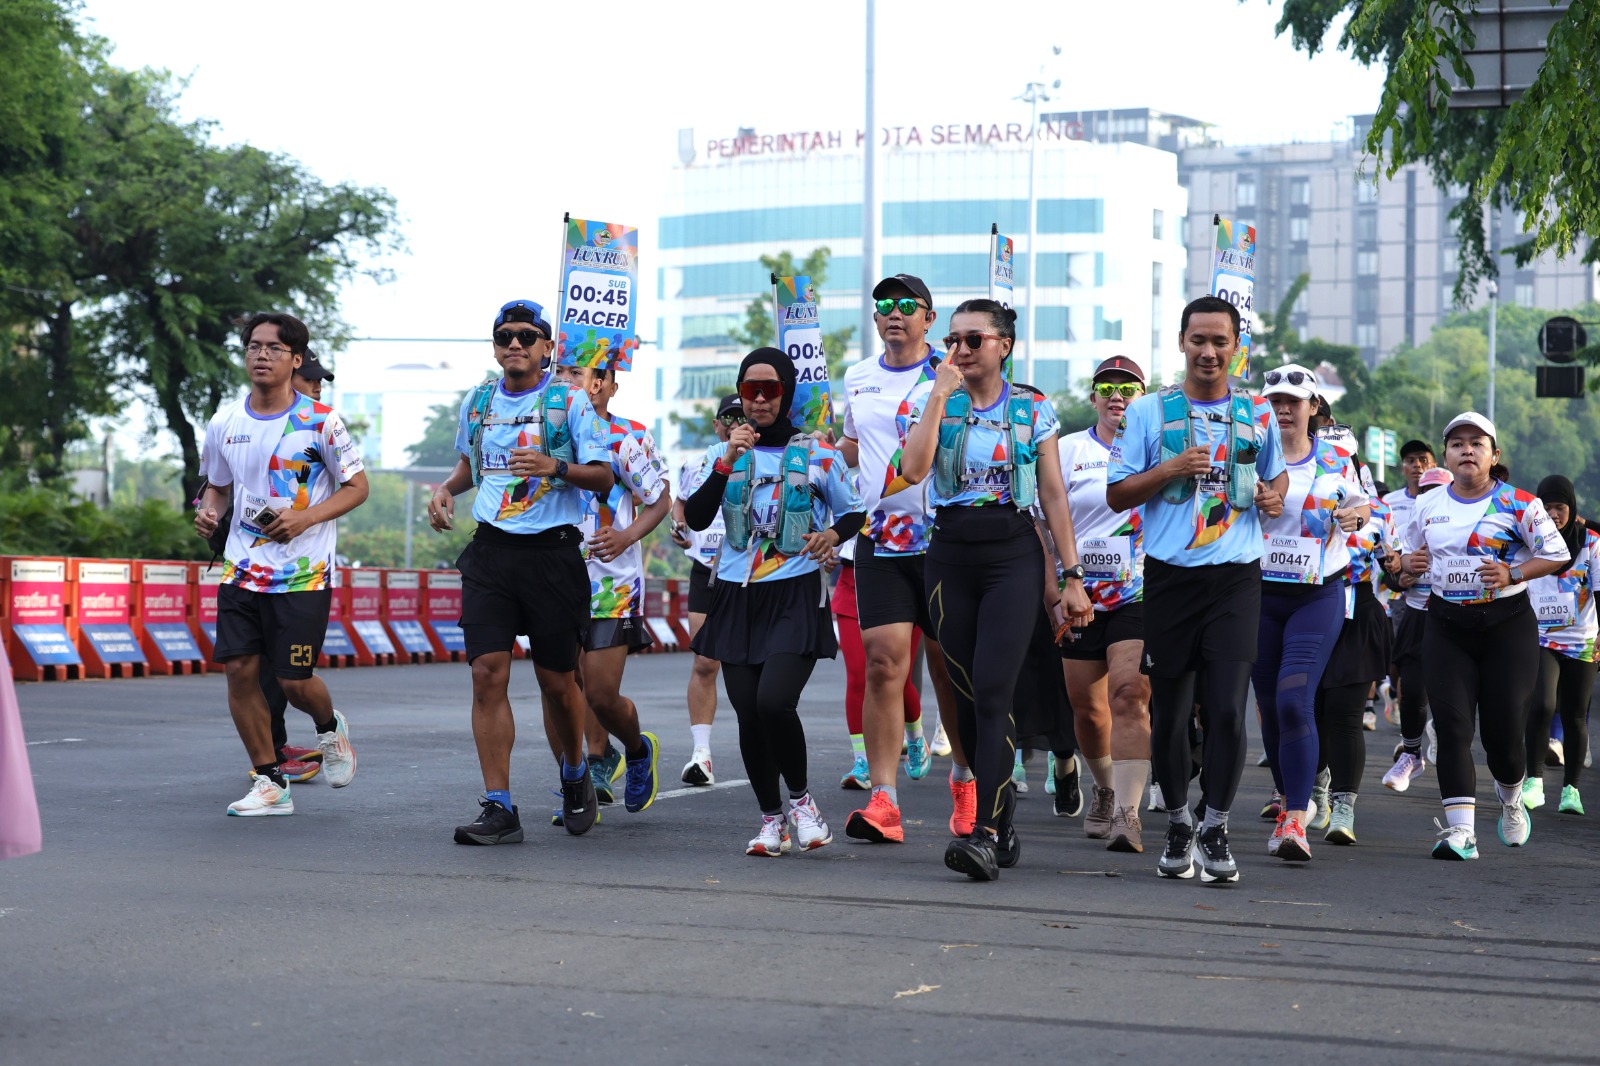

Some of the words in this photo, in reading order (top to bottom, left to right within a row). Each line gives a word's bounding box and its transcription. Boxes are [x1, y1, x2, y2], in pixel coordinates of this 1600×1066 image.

[706, 129, 842, 158] PEMERINTAH
[931, 121, 1084, 145] SEMARANG
[608, 279, 627, 289] SUB
[570, 284, 628, 307] 00:45
[1217, 288, 1251, 312] 00:4
[564, 307, 629, 329] PACER
[787, 342, 824, 361] 00:4
[1083, 553, 1122, 565] 00999
[1270, 552, 1311, 567] 00447
[1448, 572, 1477, 584] 0047
[1540, 605, 1569, 615] 01303
[290, 644, 312, 667] 23
